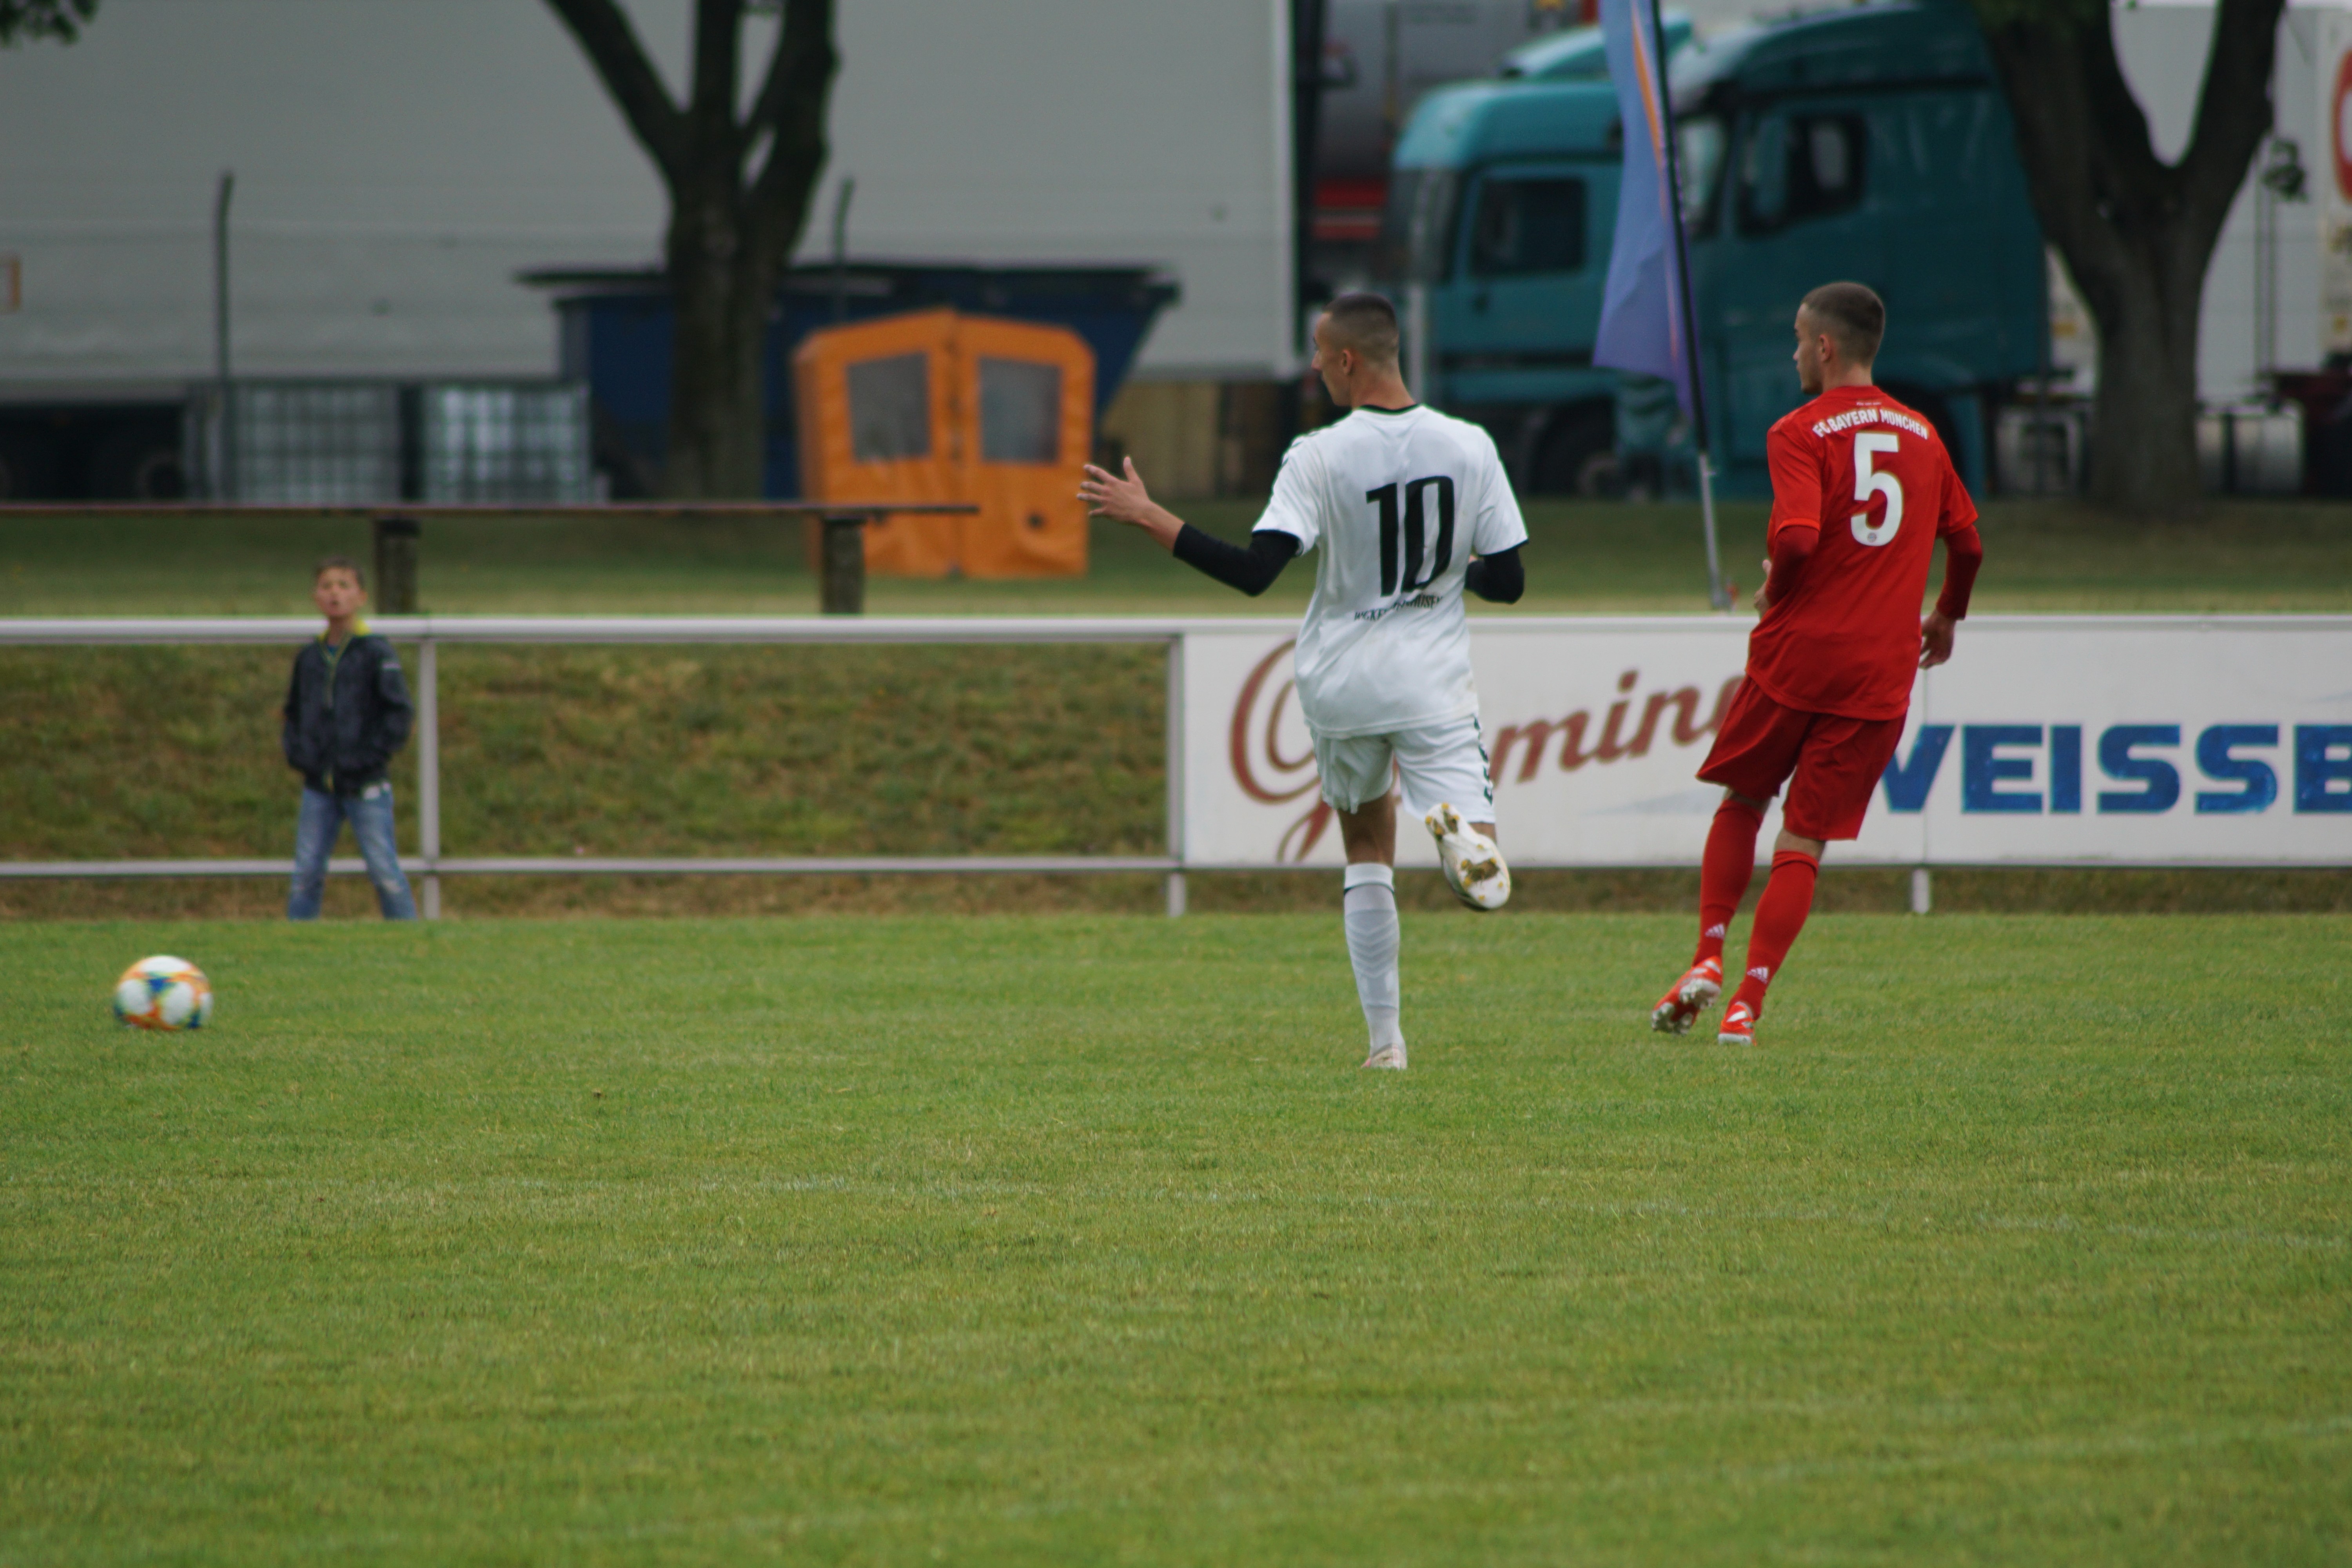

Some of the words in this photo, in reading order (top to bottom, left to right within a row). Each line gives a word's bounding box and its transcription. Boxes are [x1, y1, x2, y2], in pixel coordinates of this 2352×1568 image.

[1812, 422, 1831, 437] FC
[1827, 409, 1878, 432] BAYERN
[1365, 475, 1455, 598] 10
[1850, 432, 1903, 546] 5
